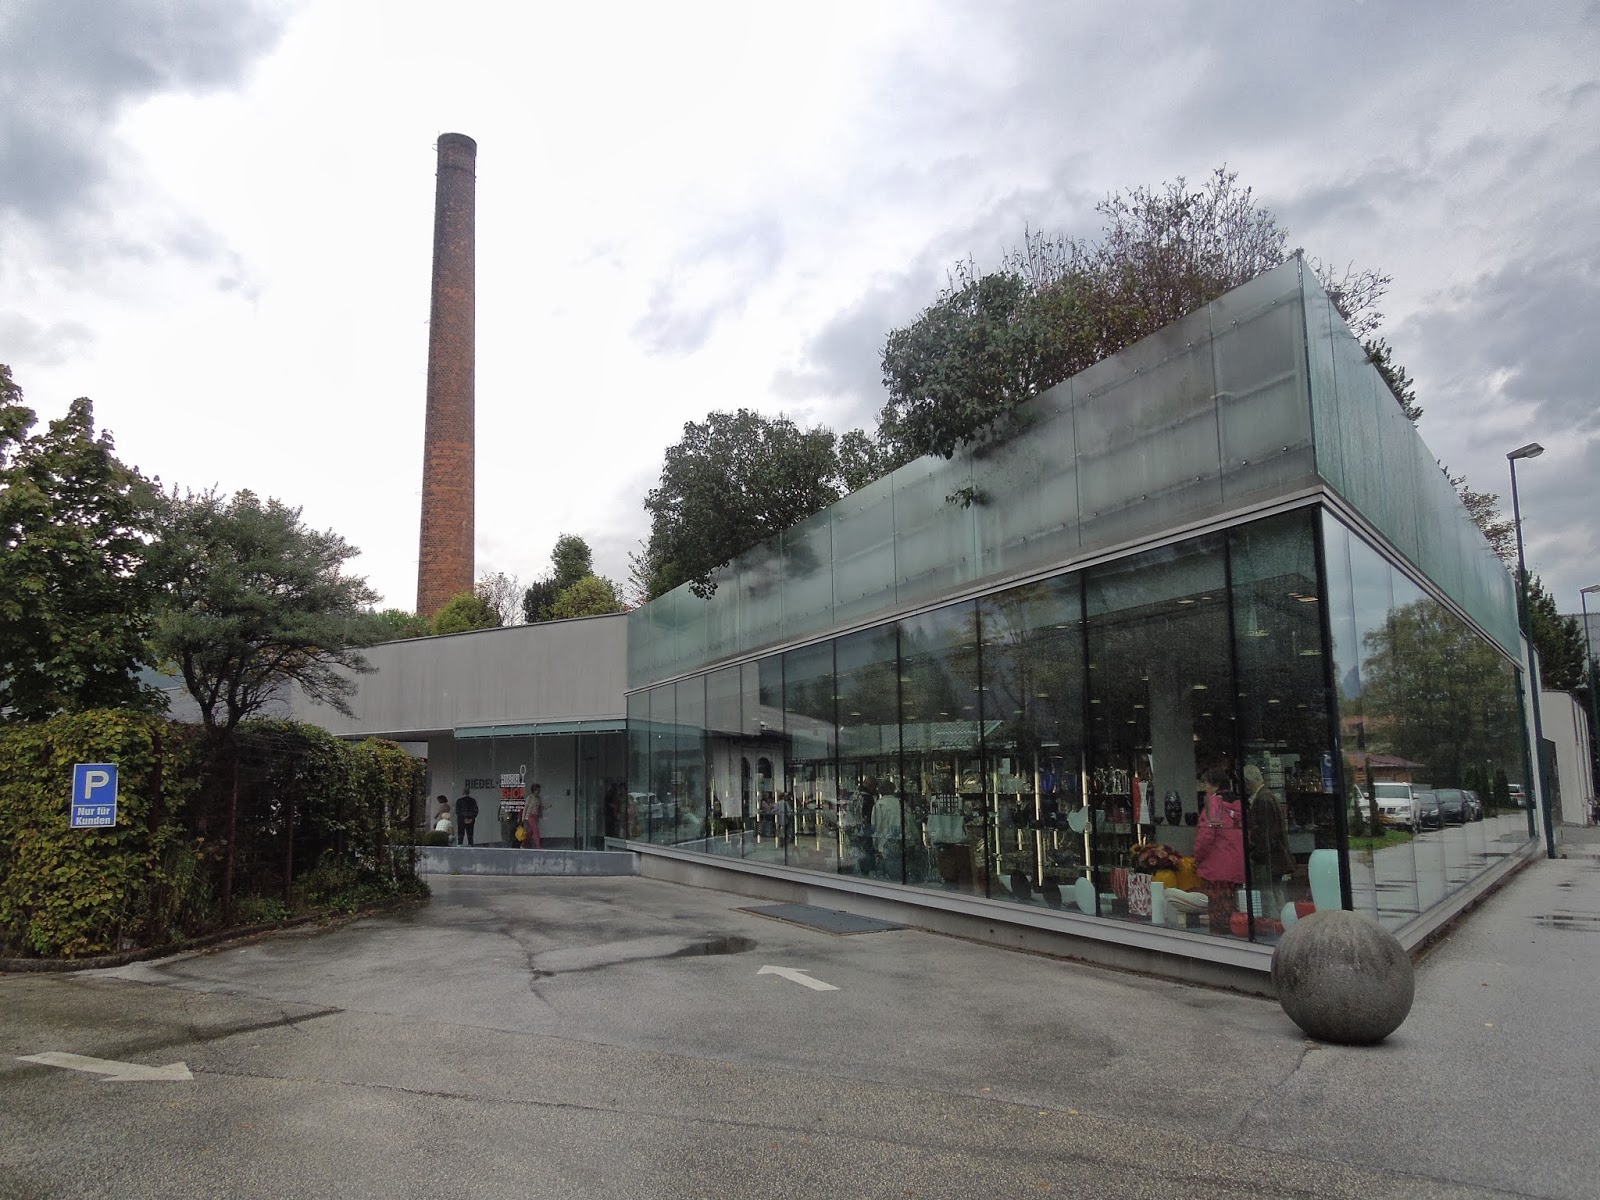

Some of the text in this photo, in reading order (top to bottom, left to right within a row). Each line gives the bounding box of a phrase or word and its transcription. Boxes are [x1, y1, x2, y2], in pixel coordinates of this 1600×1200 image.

[85, 770, 109, 799] P
[464, 778, 496, 790] RIEDEL
[501, 788, 526, 799] SHOP
[77, 806, 110, 815] Nur für
[75, 817, 111, 825] Kunden
